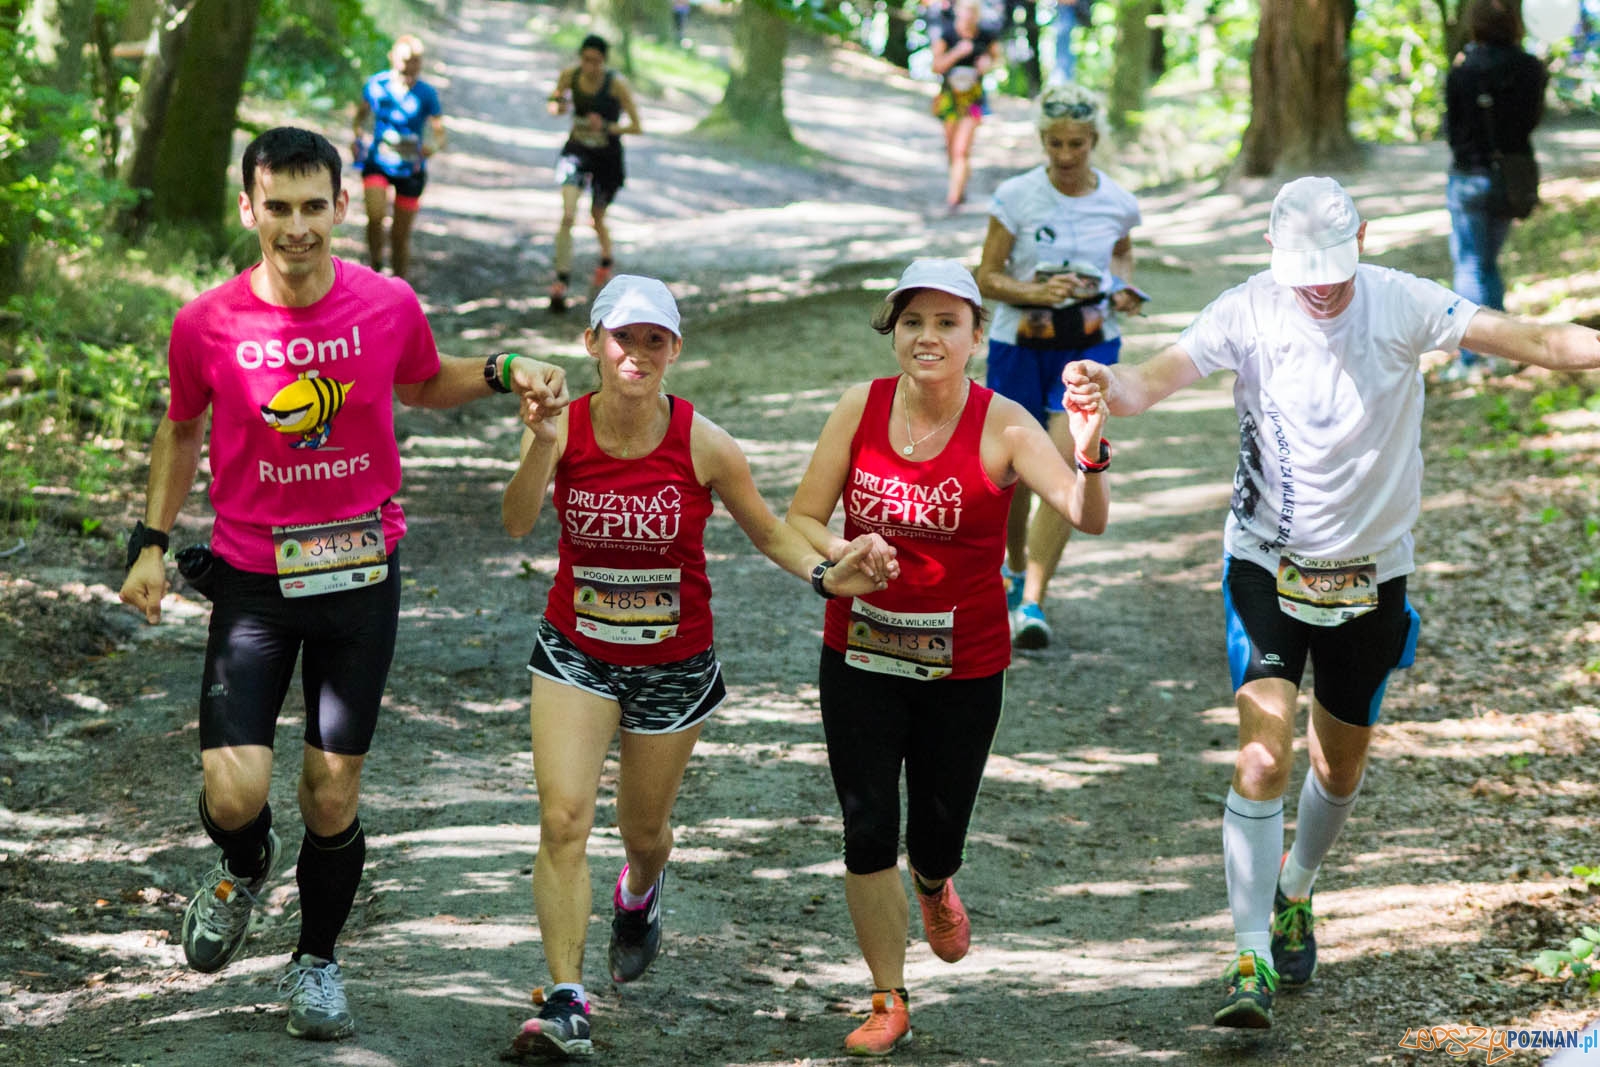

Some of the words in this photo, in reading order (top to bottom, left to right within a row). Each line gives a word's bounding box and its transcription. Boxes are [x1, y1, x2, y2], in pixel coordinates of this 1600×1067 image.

[236, 325, 361, 369] OSOm!
[258, 452, 370, 484] Runners
[1280, 465, 1293, 479] ZA
[853, 467, 943, 505] DRUŻYNA
[567, 487, 662, 513] DRUŻYNA
[849, 489, 963, 532] SZPIKU
[565, 509, 682, 540] SZPIKU
[309, 531, 353, 557] 343
[1320, 560, 1332, 568] ZA
[617, 575, 630, 583] ZA
[632, 574, 672, 583] WILKIEM
[1306, 573, 1346, 593] 259
[602, 590, 646, 610] 485
[891, 617, 903, 626] ZA
[905, 617, 946, 626] WILKIEM
[879, 631, 919, 650] 313
